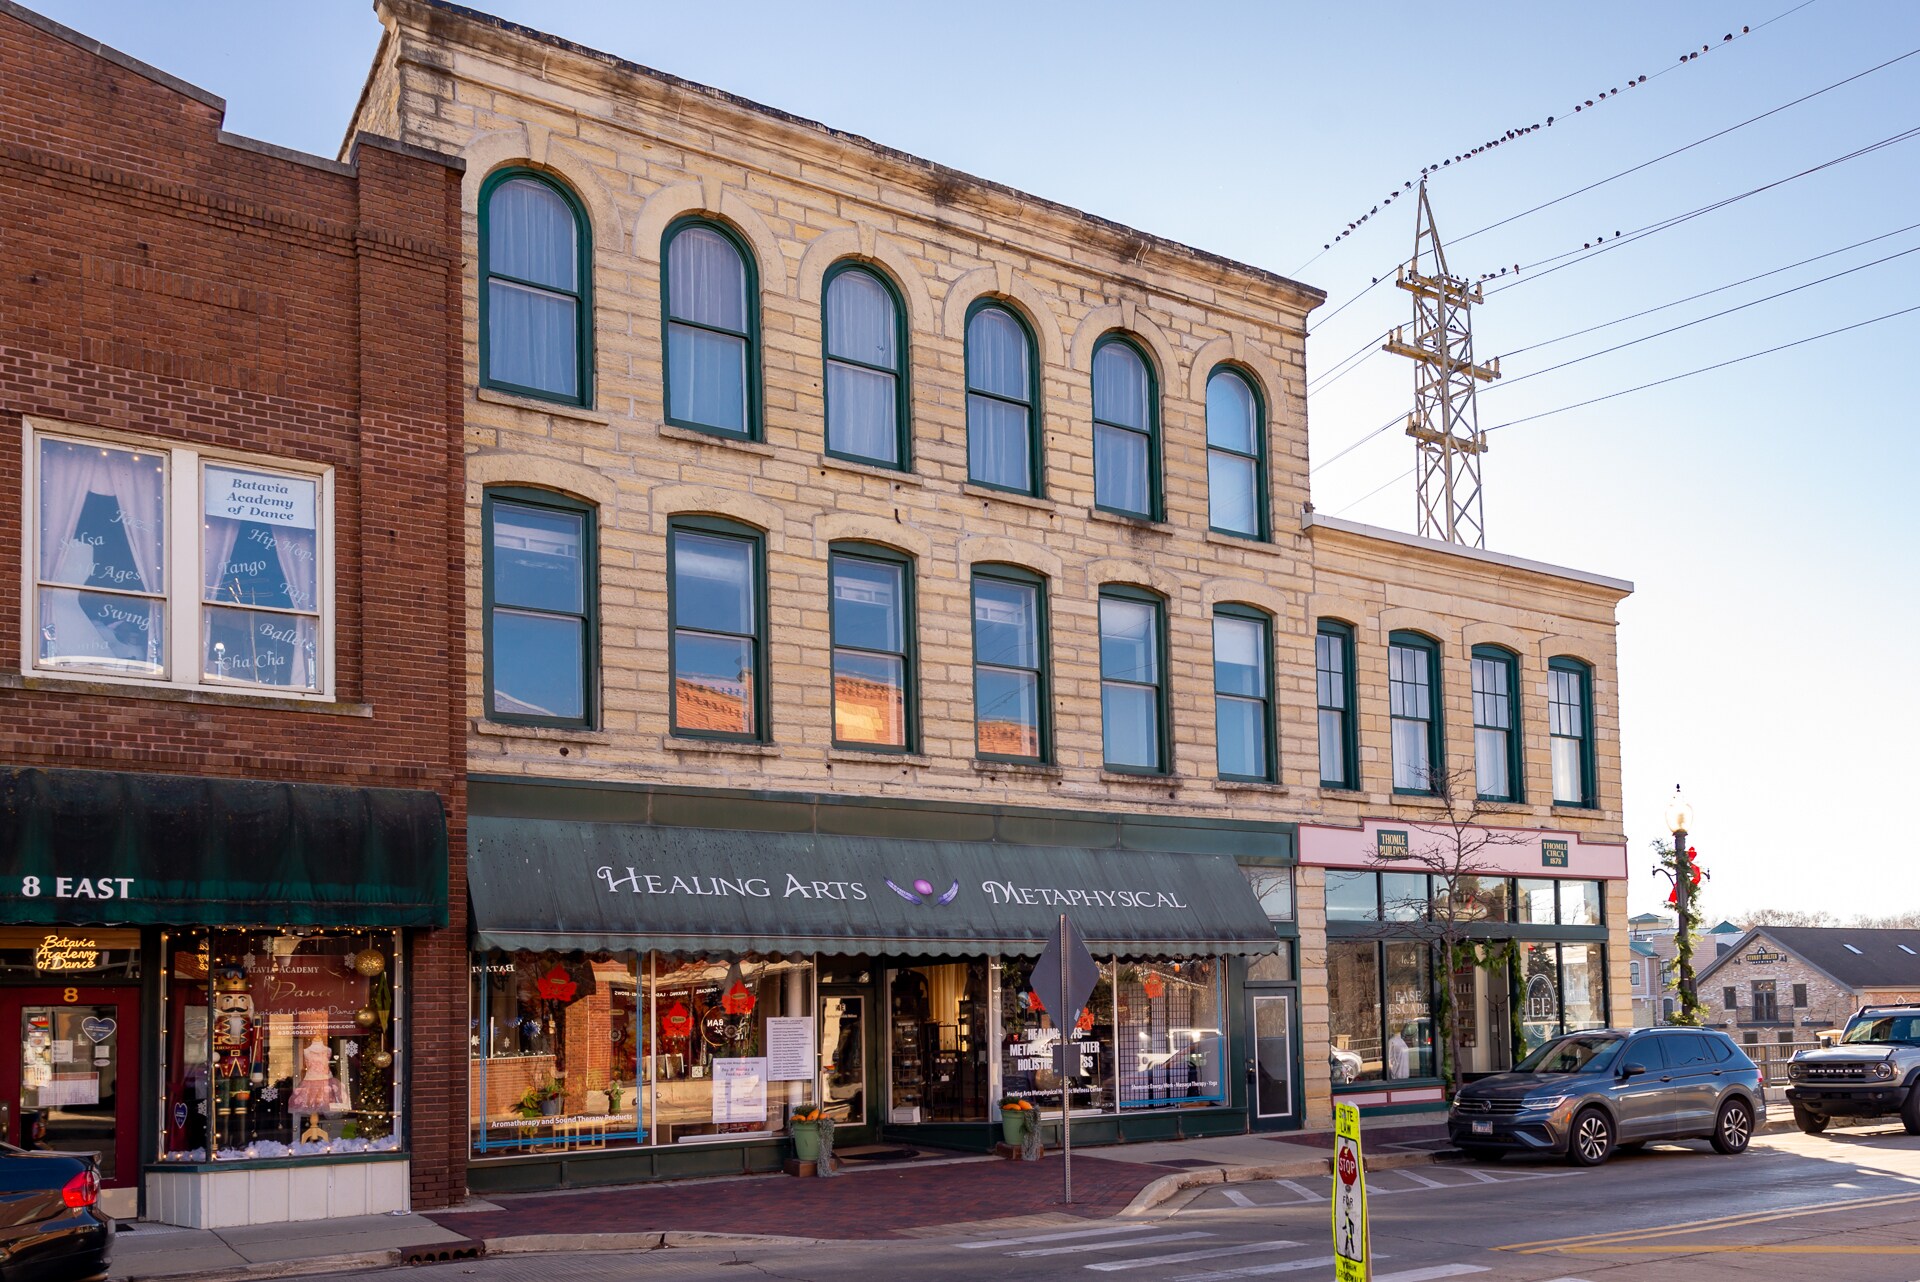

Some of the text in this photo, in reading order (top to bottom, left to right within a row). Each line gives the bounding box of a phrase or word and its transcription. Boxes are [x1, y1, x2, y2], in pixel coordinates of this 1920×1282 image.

[232, 478, 289, 494] Batavia
[226, 492, 294, 510] Academy
[228, 506, 294, 521] of Dance
[248, 529, 312, 562] Hip Hop
[99, 565, 142, 584] Ages
[217, 559, 267, 576] Tango
[280, 582, 310, 604] Tap
[98, 604, 151, 631] Swing
[221, 651, 285, 670] Cha Cha
[1381, 834, 1406, 845] THOMLE
[1546, 850, 1564, 858] CIRCA
[22, 876, 134, 899] 8 EAST
[40, 935, 96, 949] Batavia
[36, 947, 99, 960] Academy
[36, 958, 96, 970] of Dance
[63, 987, 78, 1002] 8
[1396, 990, 1422, 1002] EASE
[1388, 1003, 1430, 1014] ESCAPE
[1530, 998, 1552, 1018] EE
[1028, 1028, 1060, 1040] HEALING
[492, 1118, 541, 1128] Aromatherapy
[555, 1116, 576, 1124] Sound
[577, 1115, 604, 1123] Therapy
[1339, 1108, 1354, 1122] STATE
[1340, 1158, 1355, 1174] STOP
